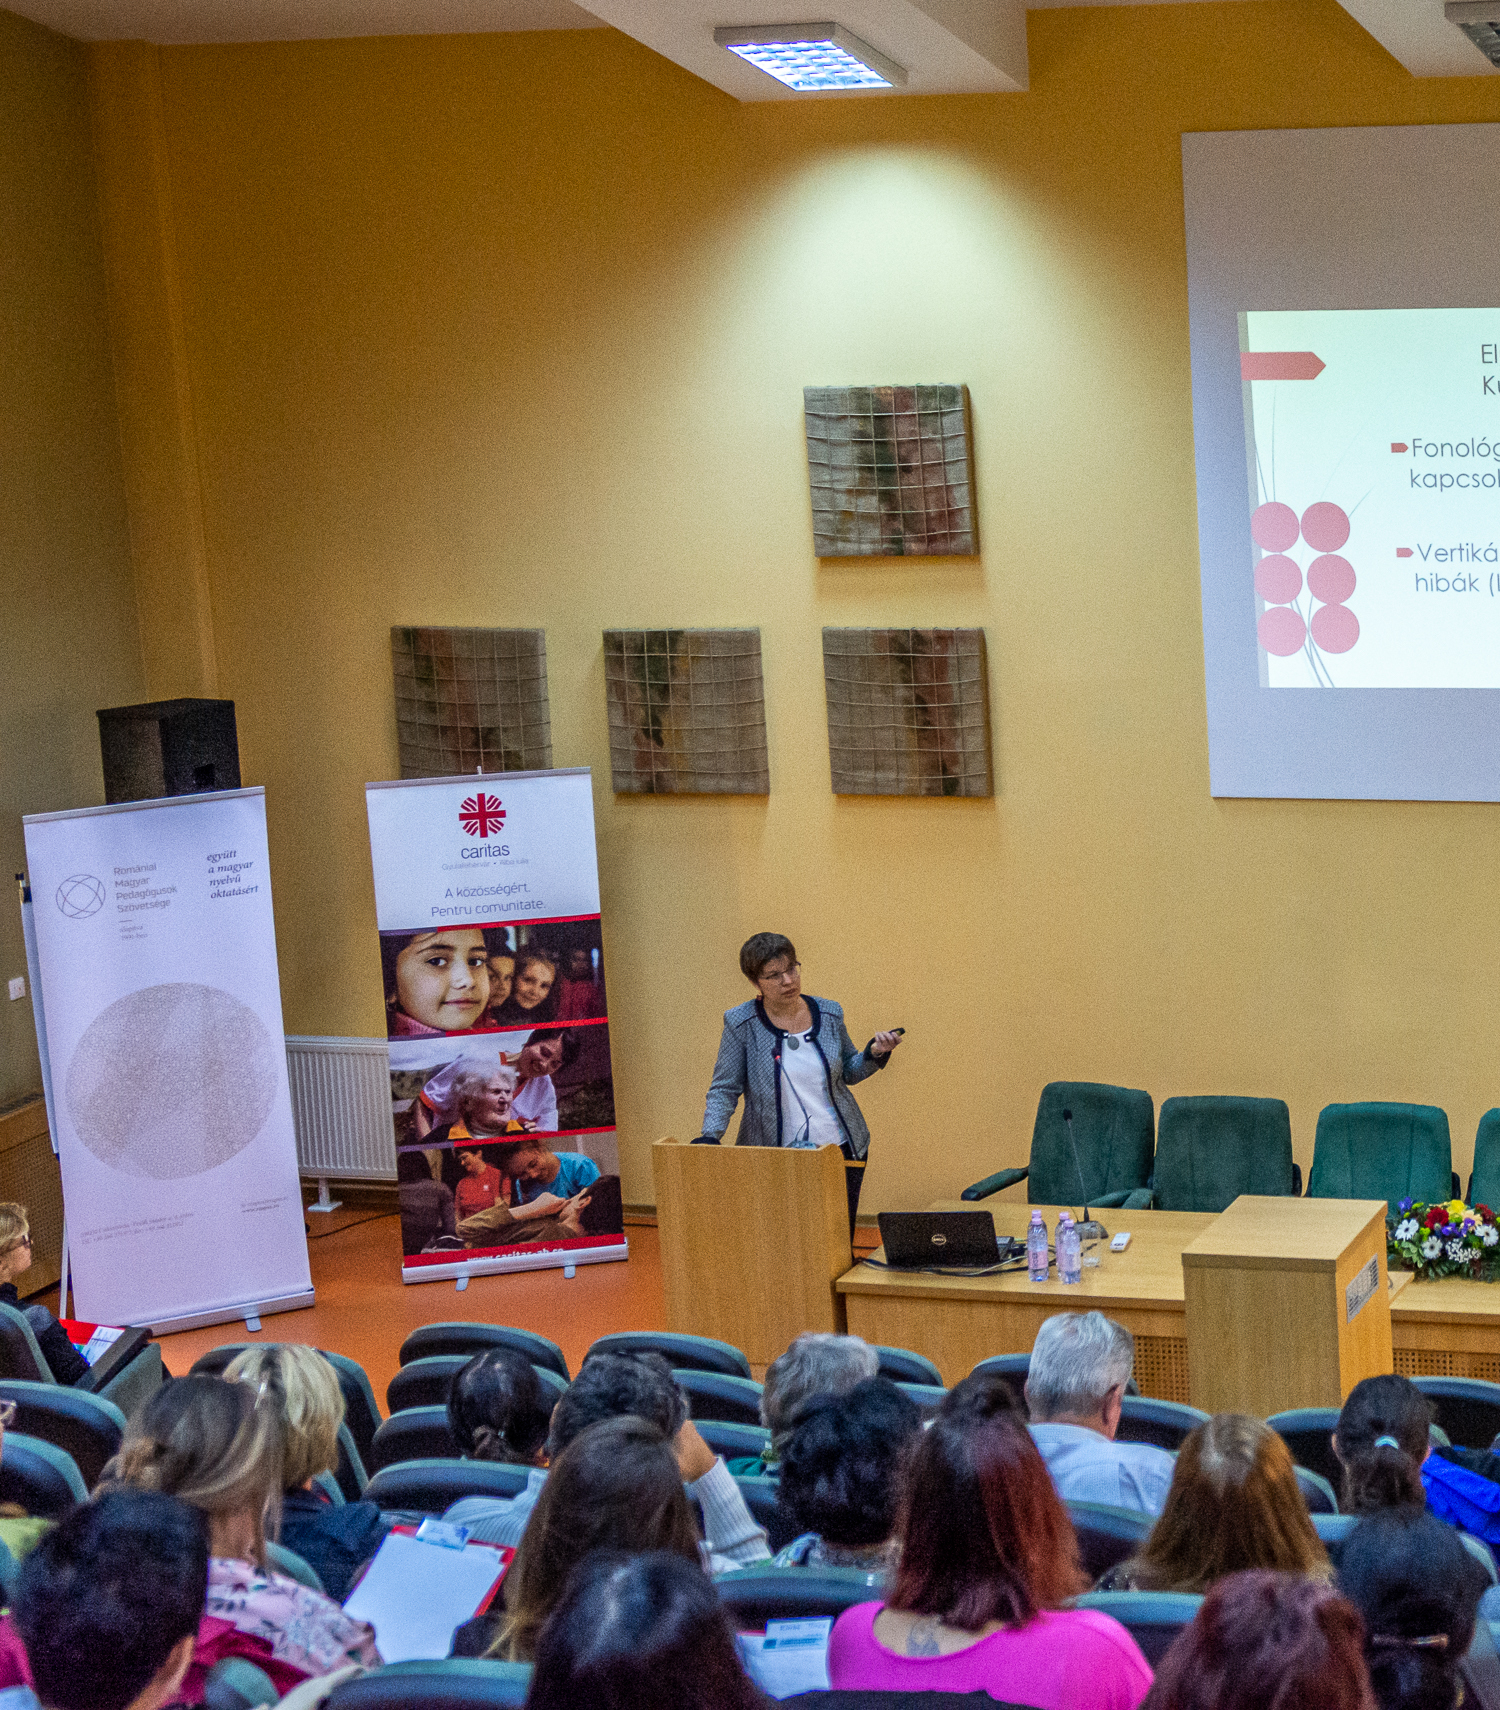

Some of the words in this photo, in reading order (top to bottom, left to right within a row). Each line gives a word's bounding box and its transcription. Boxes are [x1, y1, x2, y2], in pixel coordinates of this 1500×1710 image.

[1414, 571, 1480, 594] hibák
[206, 850, 237, 864] együtt
[460, 843, 511, 860] caritas
[113, 863, 157, 876] Romániai
[208, 866, 215, 874] a
[217, 861, 254, 874] magyar
[114, 877, 151, 889] Magyar
[115, 885, 178, 901] Pedagógusok
[210, 885, 259, 899] oktatásért
[444, 888, 454, 899] A
[431, 905, 472, 917] Pentru
[475, 900, 546, 914] comunitate.
